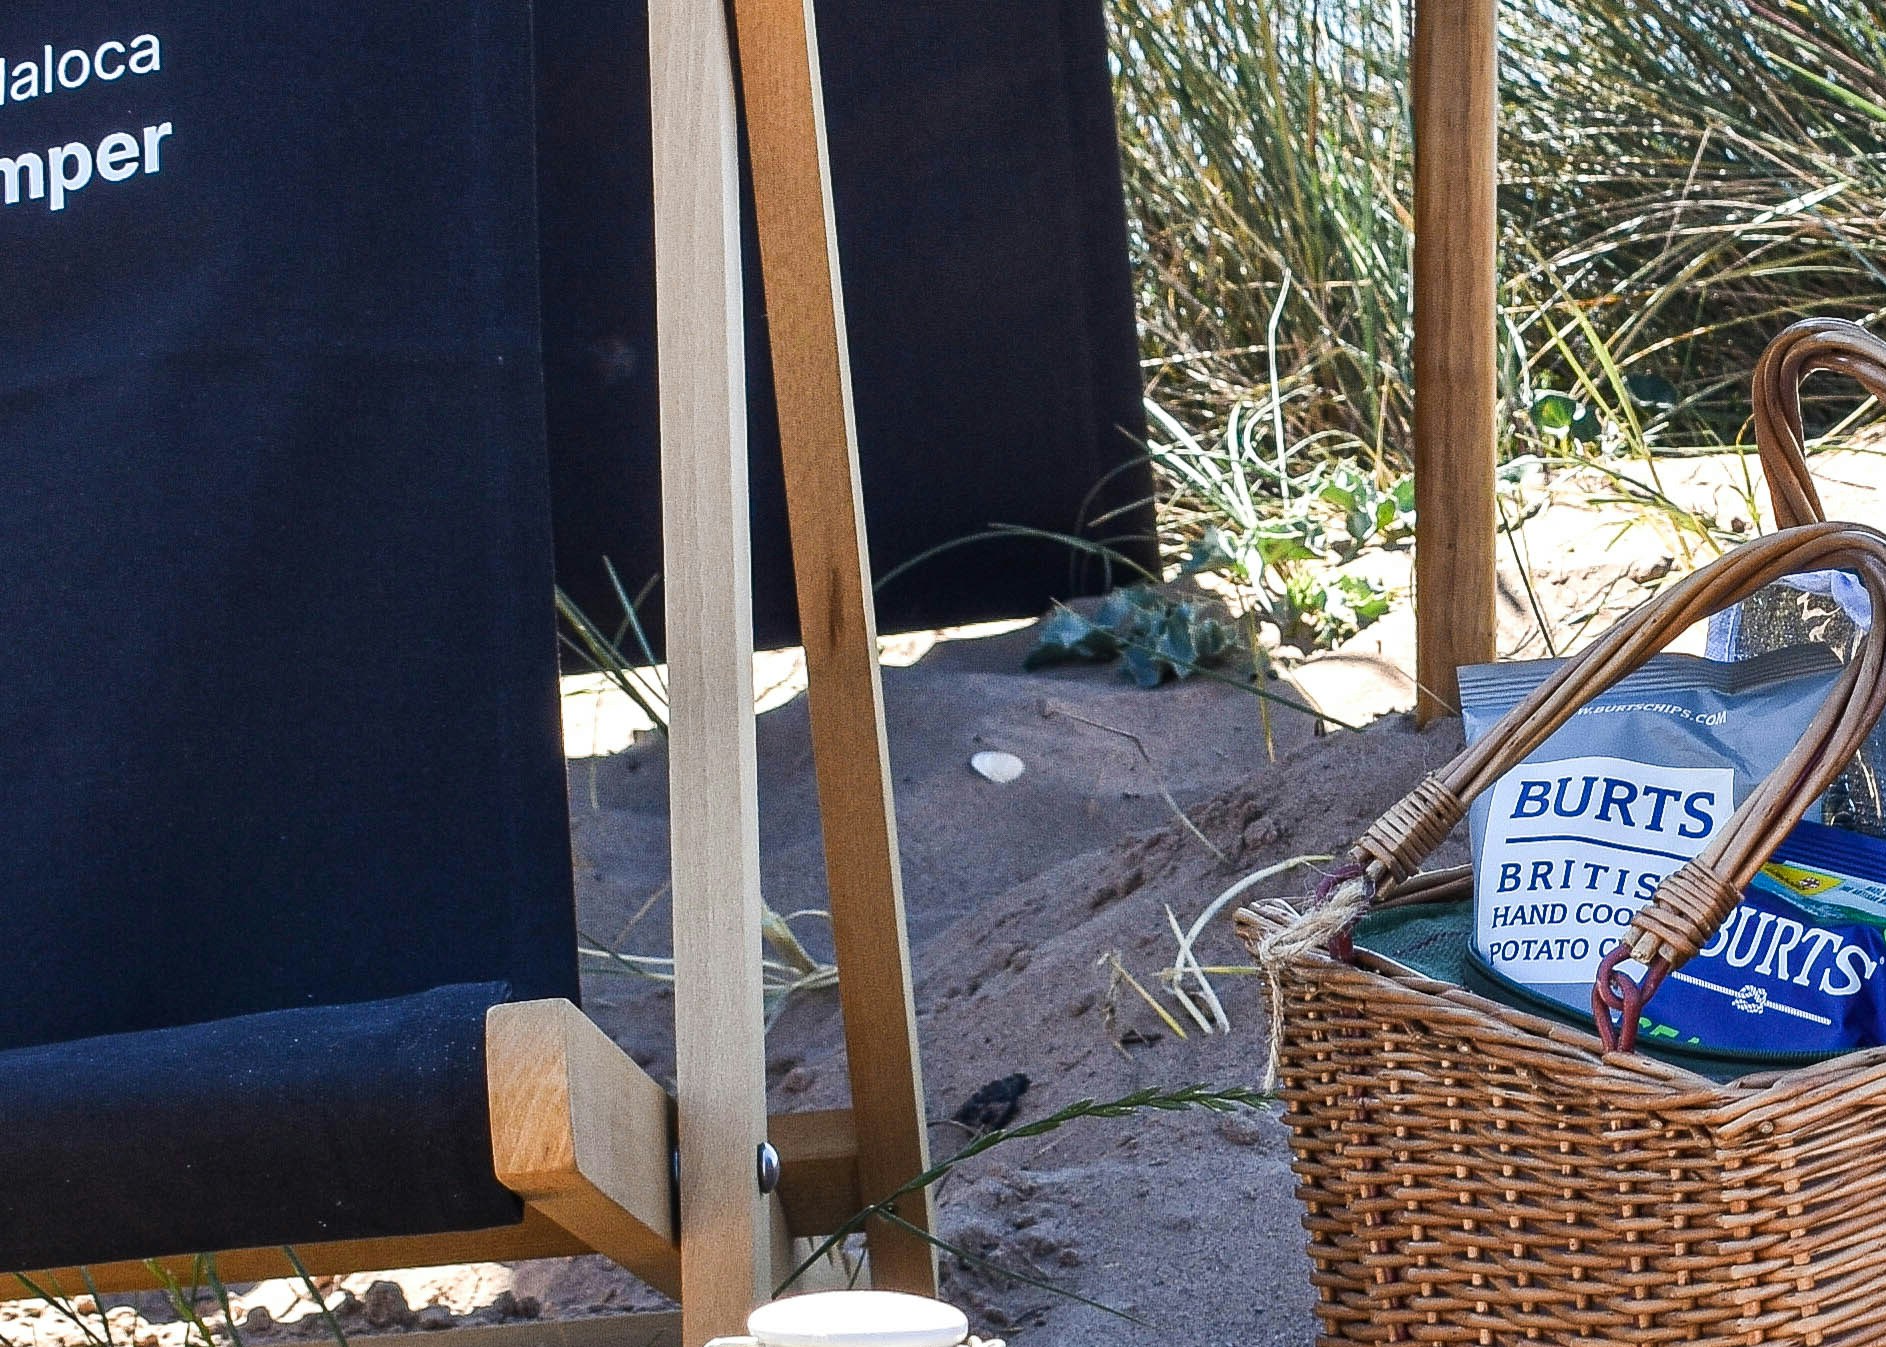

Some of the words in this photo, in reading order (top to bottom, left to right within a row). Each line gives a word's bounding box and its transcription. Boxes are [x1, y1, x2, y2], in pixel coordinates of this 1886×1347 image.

[0, 122, 172, 211] mper
[1576, 703, 1727, 726] W.BURTSCHIPS.COM
[1510, 776, 1715, 839] BURTS
[1497, 859, 1661, 901] BRITIS
[1491, 902, 1568, 929] HAND
[1575, 902, 1635, 927] COO
[1489, 937, 1590, 966] POTATO
[1700, 905, 1878, 996] BURTS
